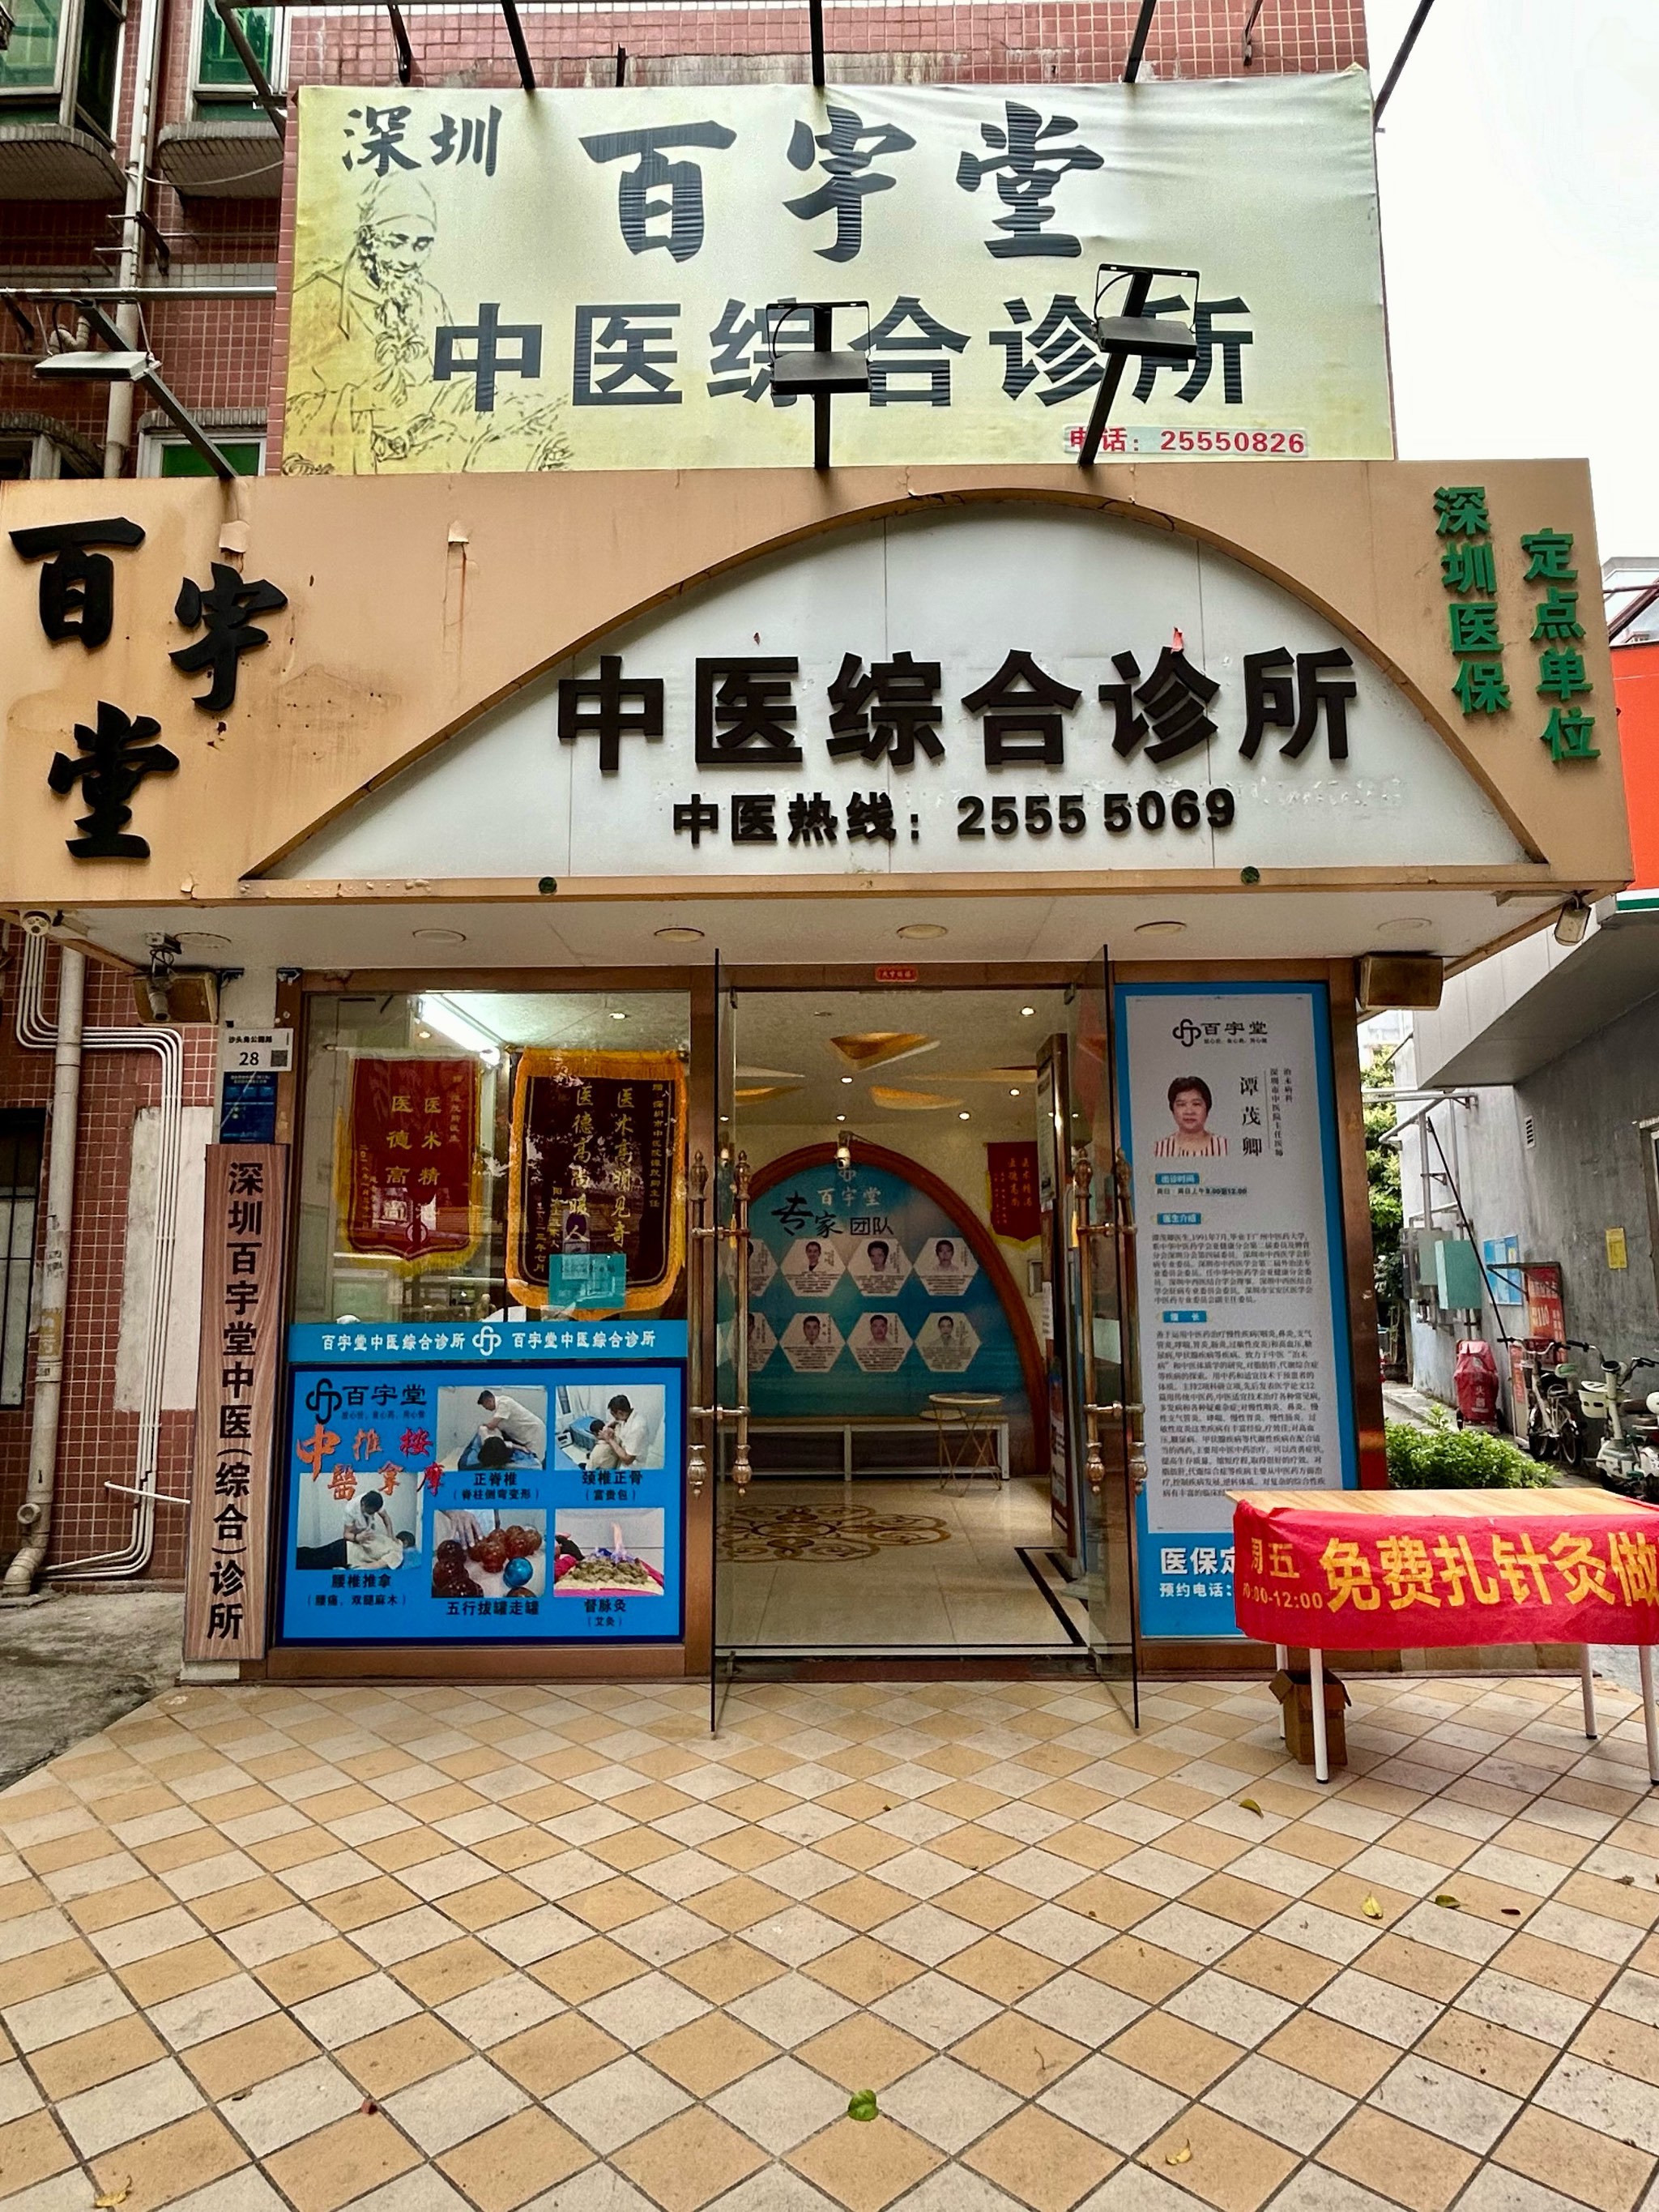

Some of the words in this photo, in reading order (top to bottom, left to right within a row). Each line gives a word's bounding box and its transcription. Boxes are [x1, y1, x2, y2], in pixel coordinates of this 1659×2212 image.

[342, 105, 502, 177] 深圳
[1160, 429, 1305, 455] 25550826
[1433, 486, 1512, 715] 深圳医保
[1520, 527, 1601, 762] 定点单位
[558, 647, 1356, 771] 中医综合诊所
[957, 794, 1086, 836] 2555
[1104, 788, 1235, 833] 5069
[239, 1052, 259, 1065] 28
[474, 1472, 518, 1486] 正脊椎
[582, 1471, 643, 1485] 颈椎正骨
[1251, 1537, 1300, 1579] 周五
[1319, 1531, 1659, 1612] 免费扎针灸做
[331, 1574, 392, 1588] 腰椎推拿
[446, 1601, 539, 1616] 五行拔罐走罐
[584, 1599, 626, 1612] 督脉灸
